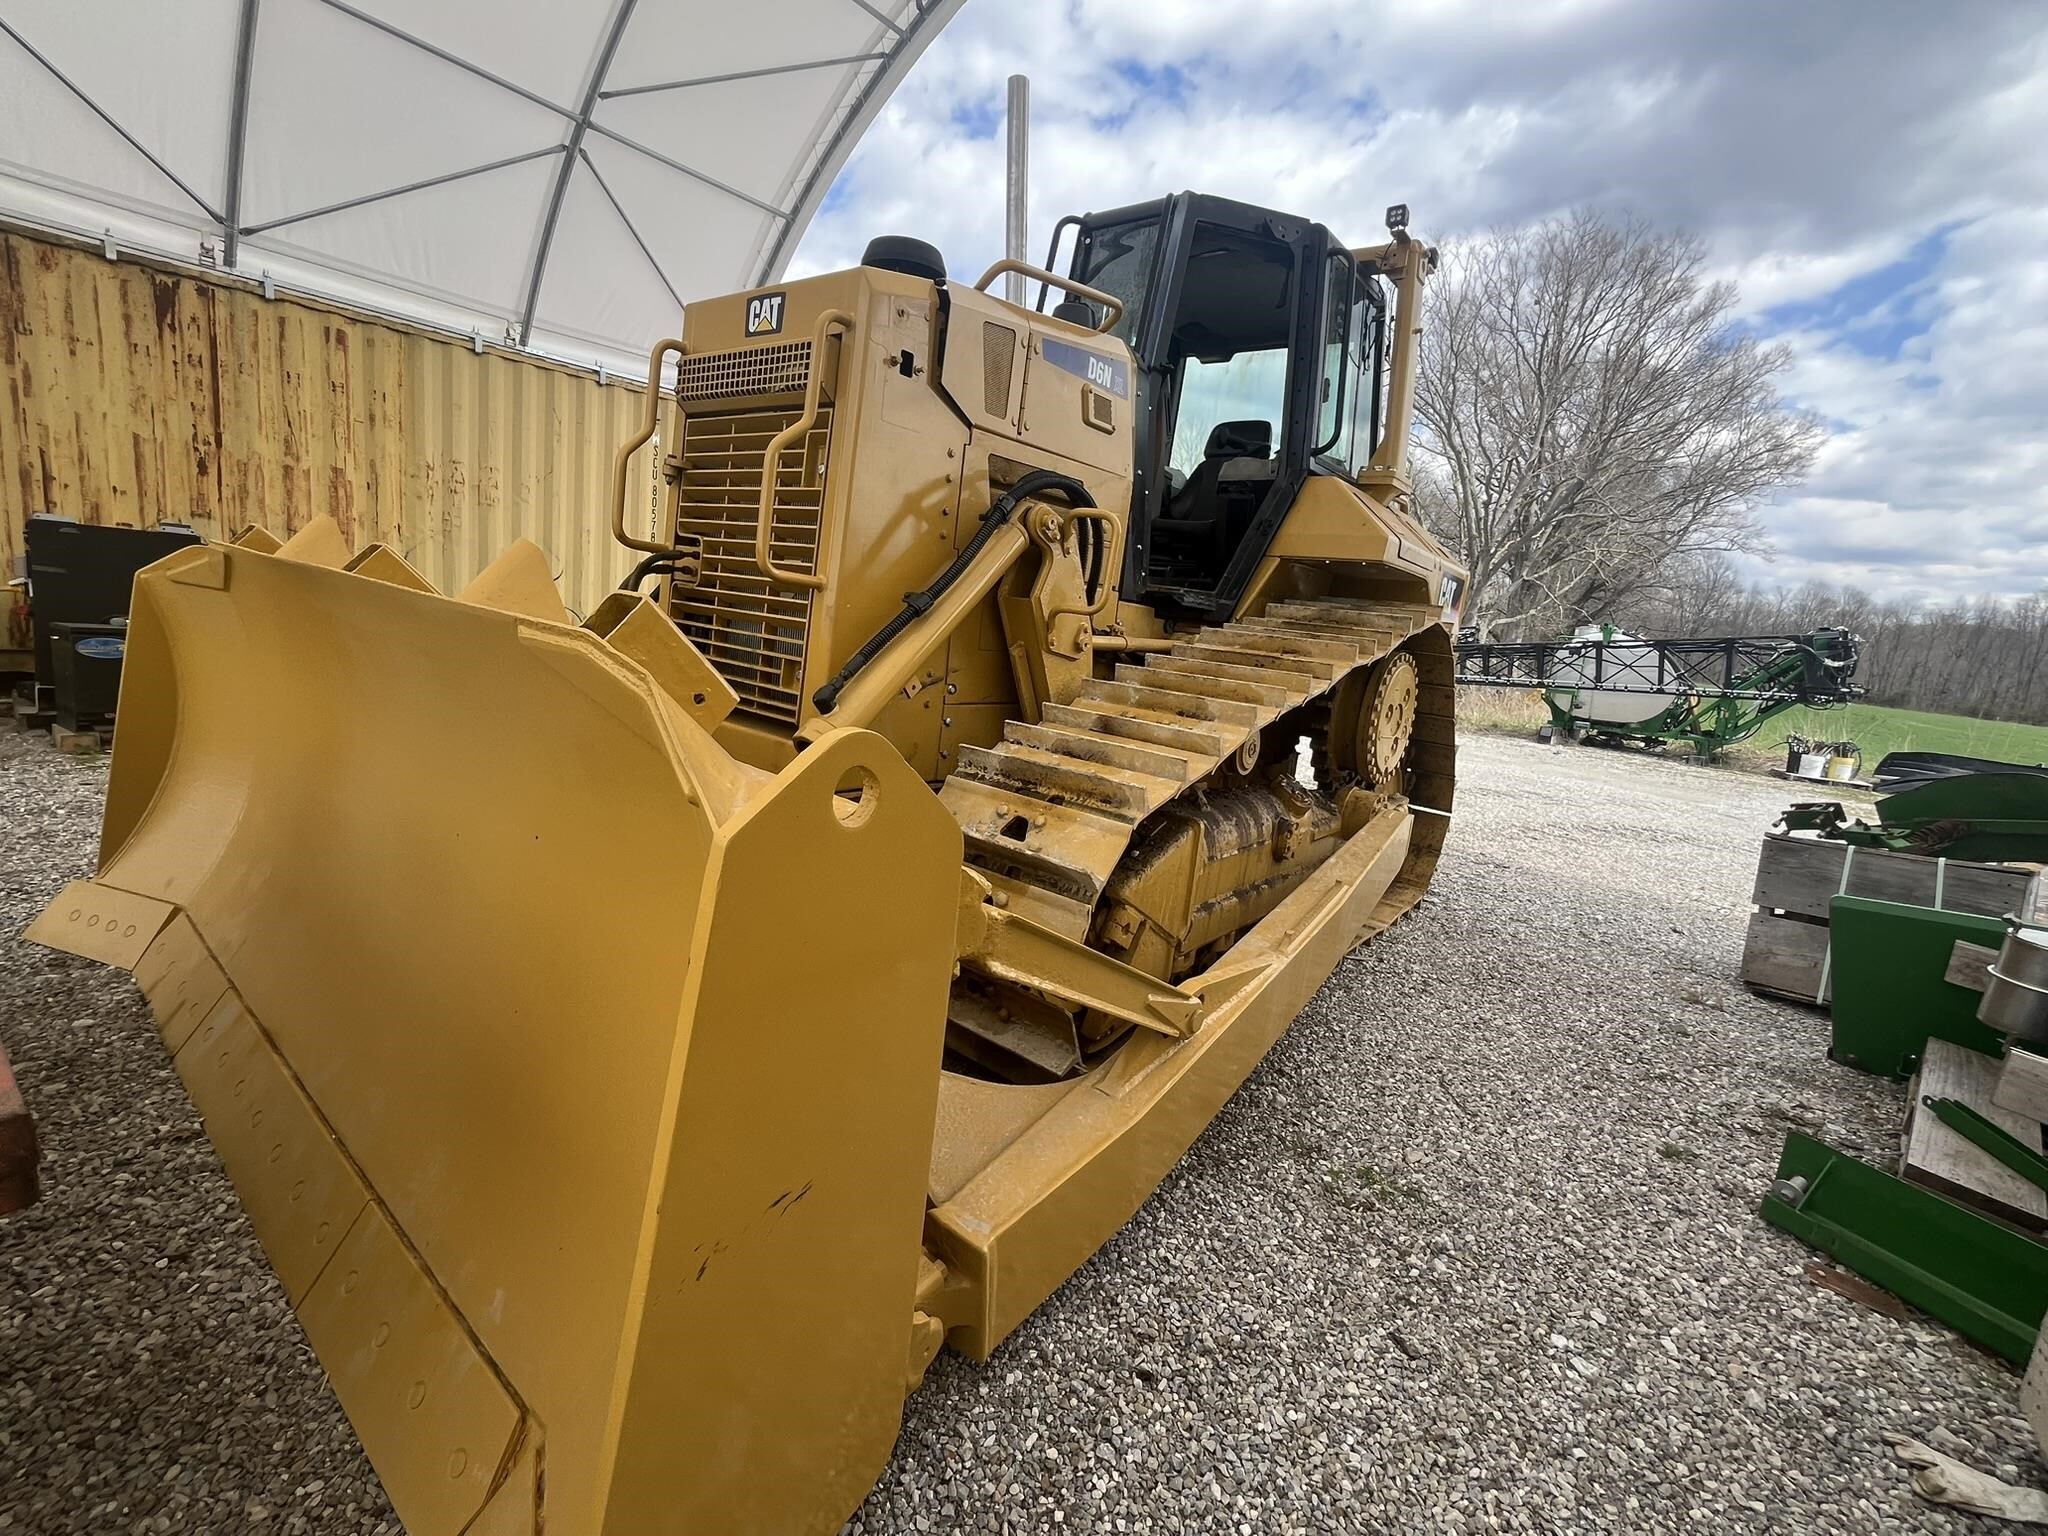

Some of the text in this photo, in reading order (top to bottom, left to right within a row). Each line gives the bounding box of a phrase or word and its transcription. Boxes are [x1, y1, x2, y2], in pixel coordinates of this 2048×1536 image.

[749, 295, 782, 332] CAT
[1088, 356, 1112, 388] D6N
[1438, 577, 1457, 613] CAT
